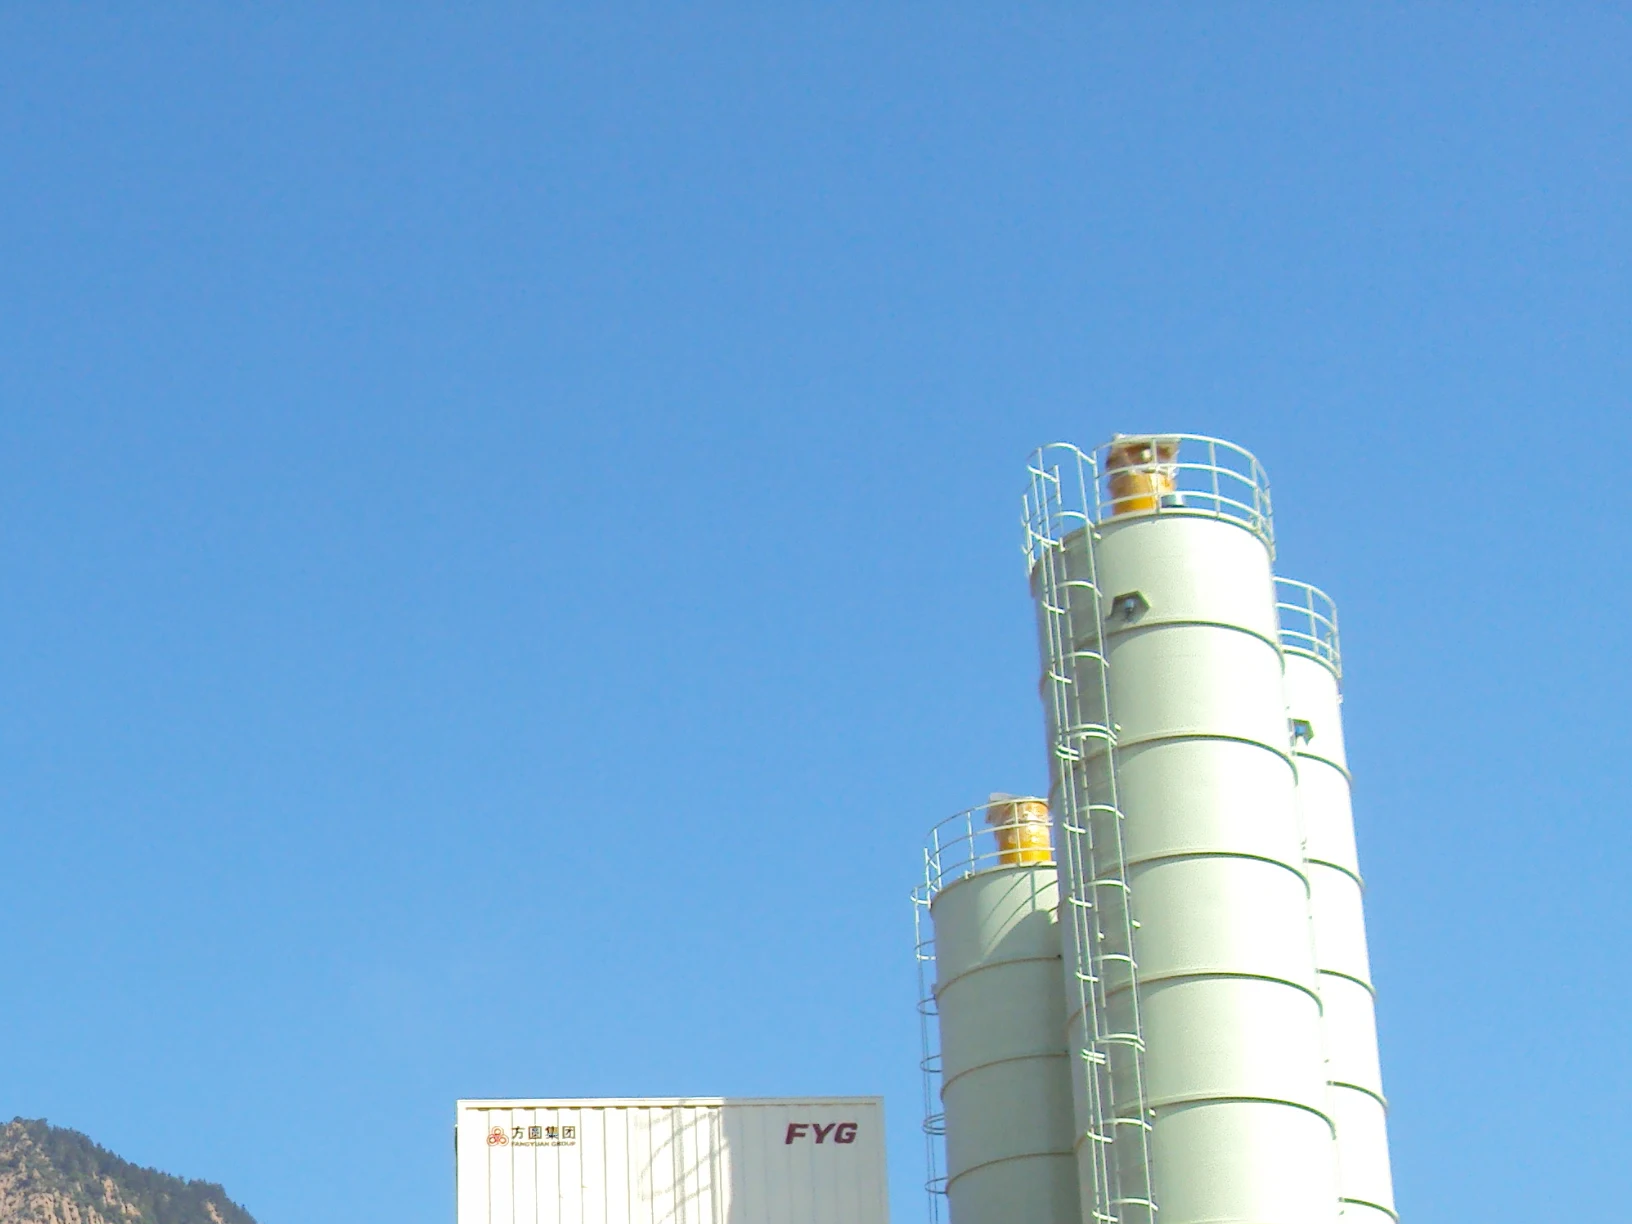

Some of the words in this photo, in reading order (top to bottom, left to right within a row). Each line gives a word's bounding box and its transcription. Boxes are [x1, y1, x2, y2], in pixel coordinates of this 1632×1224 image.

[511, 1126, 576, 1139] 方圆集团
[785, 1122, 858, 1145] FYG
